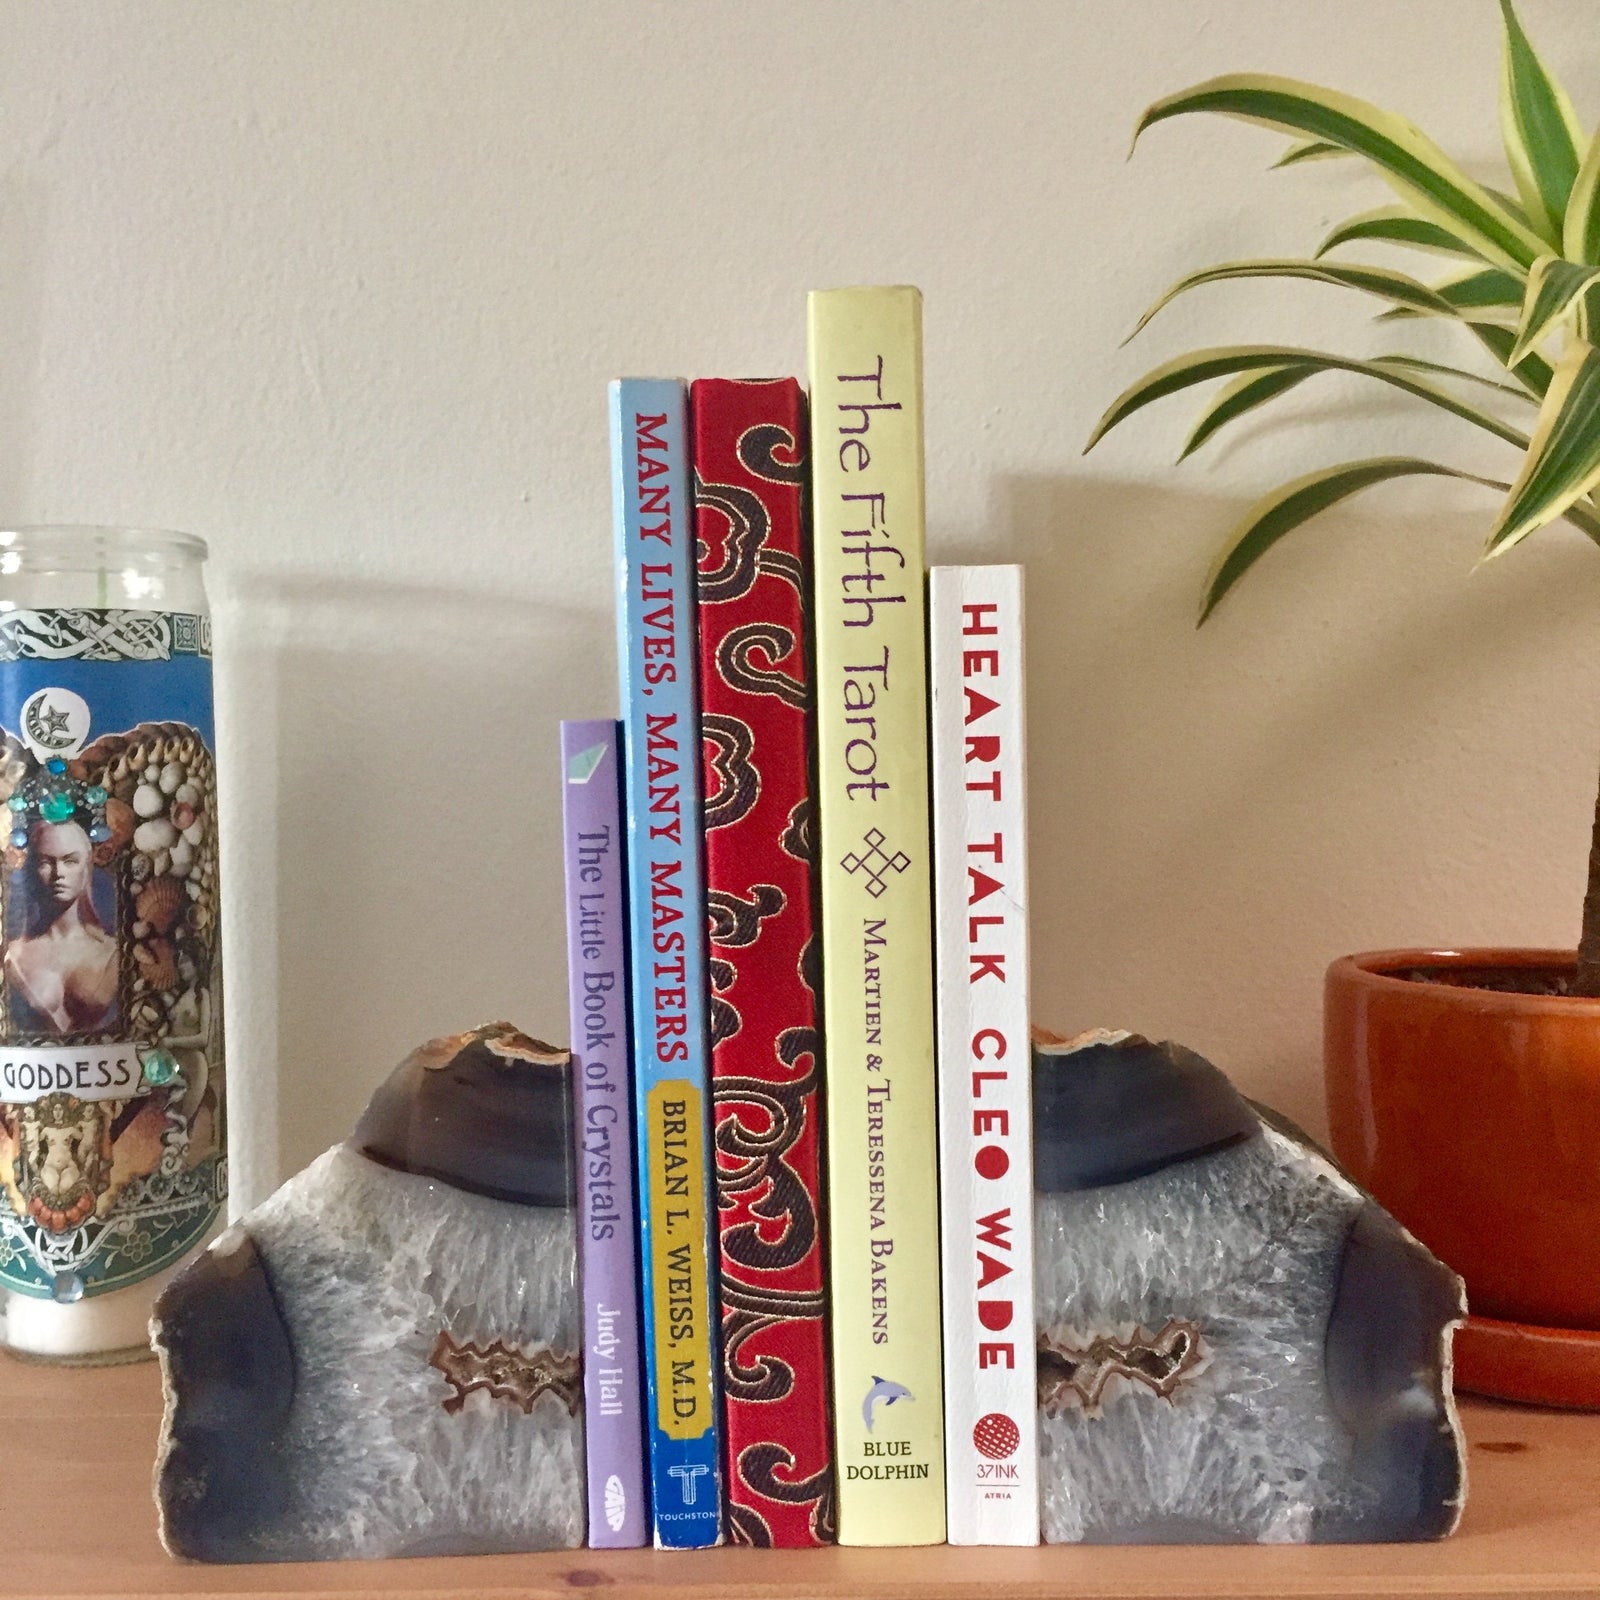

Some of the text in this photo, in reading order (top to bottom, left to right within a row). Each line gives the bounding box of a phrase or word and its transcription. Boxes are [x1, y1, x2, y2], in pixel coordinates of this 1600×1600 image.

[836, 354, 907, 802] The Fifth Tarot
[635, 412, 689, 1063] MANY LIVES, MANY MASTERS
[962, 603, 1006, 984] HEART TALK
[577, 825, 622, 1241] The Little Book of Crystals
[863, 918, 887, 1046] MARTIEN
[3, 1058, 132, 1091] GODDESS
[866, 1053, 883, 1073] &
[971, 1028, 1015, 1370] CLEO WADE
[662, 1100, 697, 1425] BRIAN L. WEISS, M.D.
[870, 1238, 894, 1345] BAKENS
[593, 1302, 623, 1416] Judy Hall
[847, 1463, 929, 1481] DOLPHIN
[863, 1441, 912, 1457] BLUE
[976, 1464, 1020, 1480] 37INK
[984, 1491, 1012, 1500] ATRIA
[659, 1511, 717, 1521] TOUCHSTON
